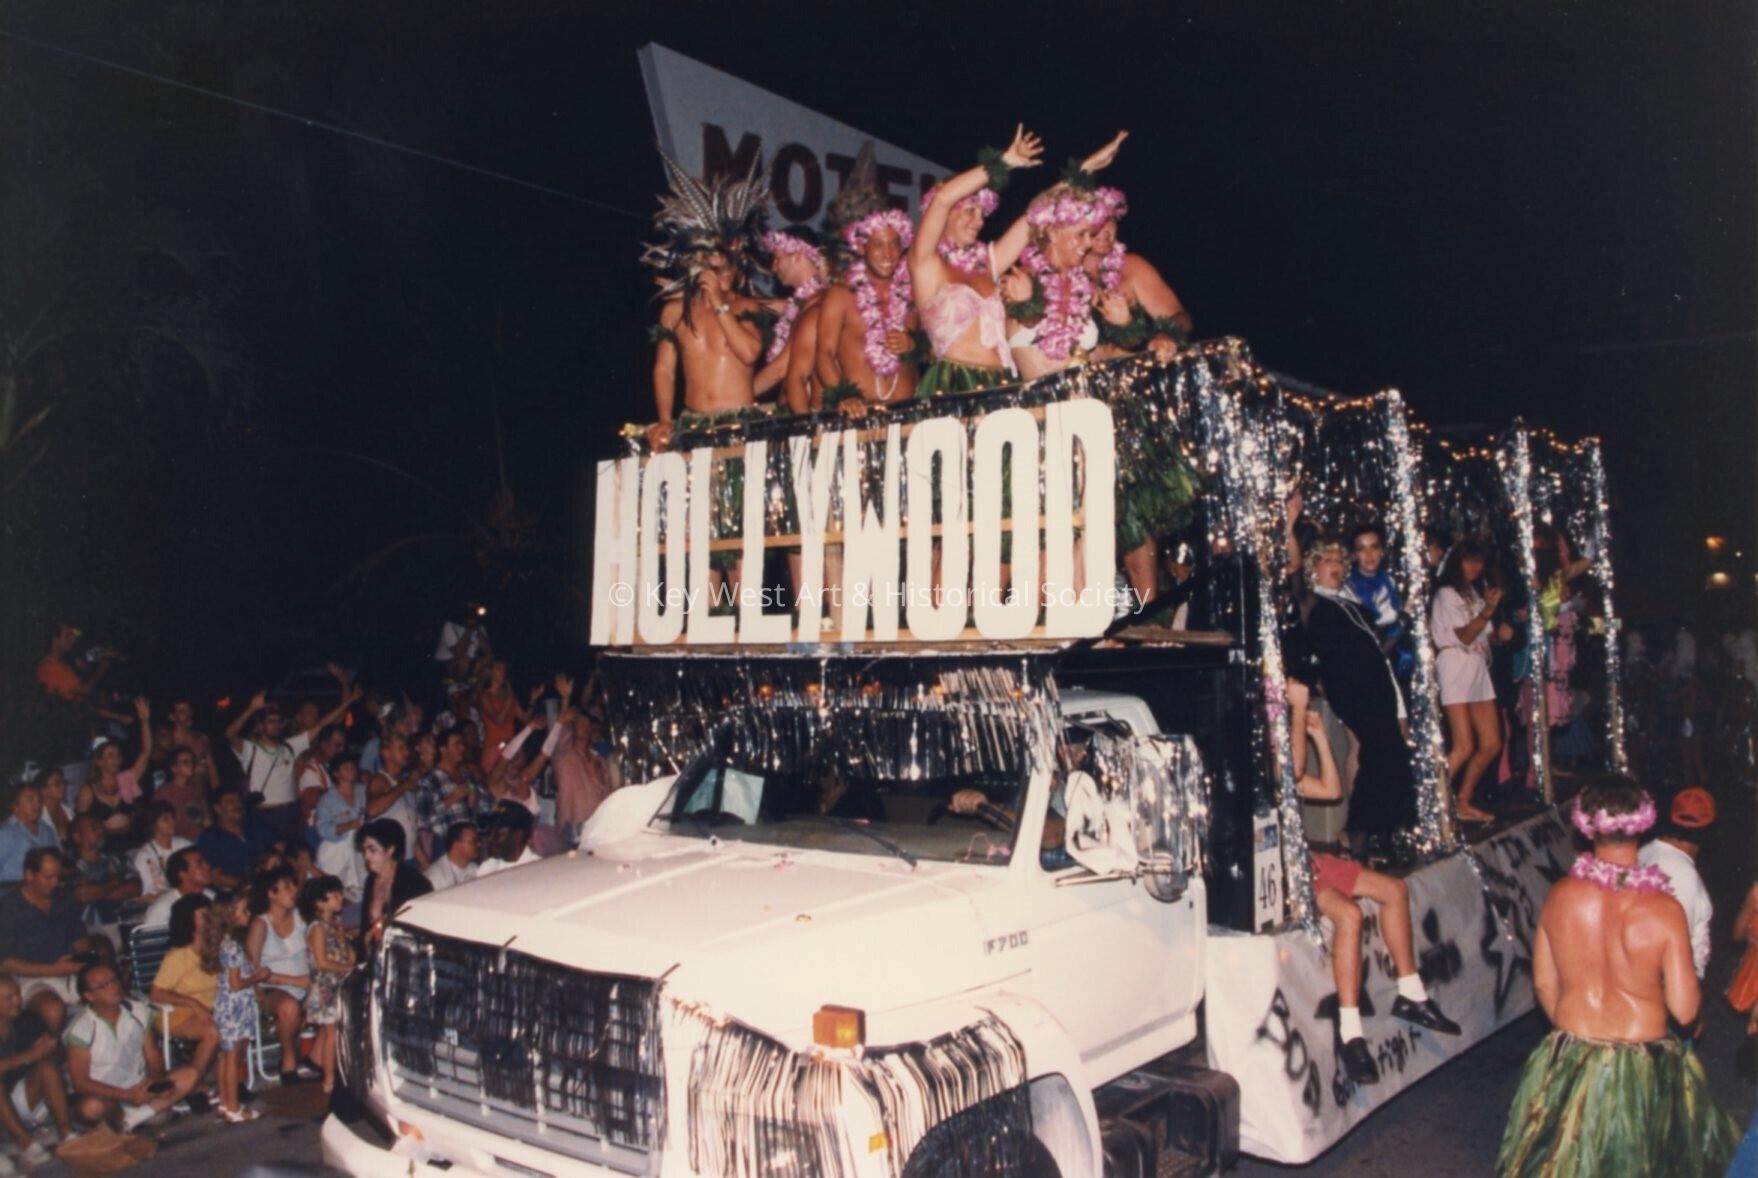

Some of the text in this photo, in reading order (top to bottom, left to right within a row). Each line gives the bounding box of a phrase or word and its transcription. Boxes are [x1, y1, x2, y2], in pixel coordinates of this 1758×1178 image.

[701, 121, 937, 224] MOTE
[590, 398, 1116, 646] HOLLYWOOD
[1259, 863, 1276, 909] 46
[984, 930, 1029, 956] F700
